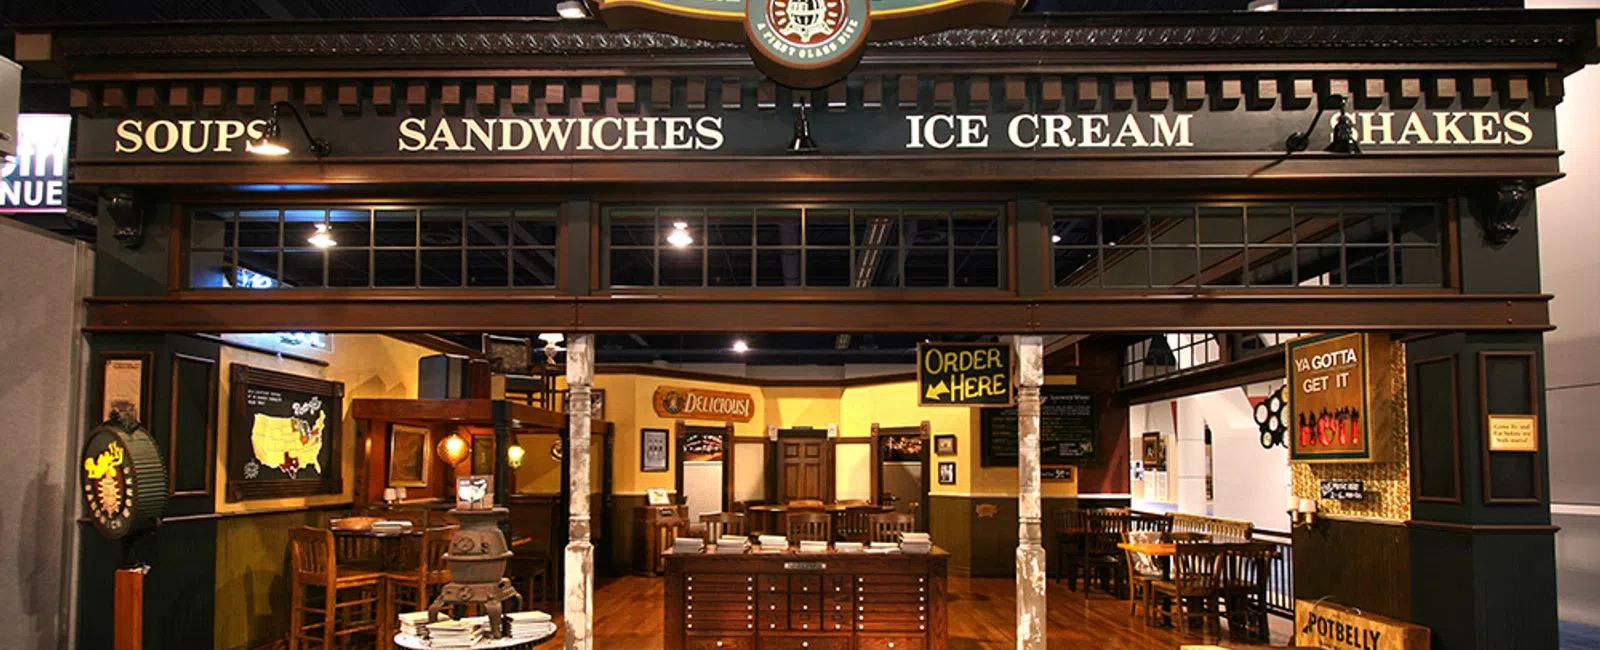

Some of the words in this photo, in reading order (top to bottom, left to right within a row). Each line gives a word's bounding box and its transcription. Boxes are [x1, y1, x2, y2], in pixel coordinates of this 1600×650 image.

[763, 31, 796, 56] FIRST
[798, 42, 838, 58] CLASS
[116, 120, 269, 153] SOUPS
[399, 116, 724, 152] SANDWICHES
[906, 115, 990, 149] ICE
[1008, 113, 1194, 149] CREAM
[924, 348, 1003, 375] ORDER
[1295, 358, 1310, 372] YA
[1311, 348, 1357, 370] GOTTA
[950, 373, 1006, 402] HERE
[1302, 376, 1329, 393] GET
[1336, 372, 1349, 388] IT
[684, 392, 750, 417] DELICIOUS!
[1309, 611, 1381, 650] POTBELLY
